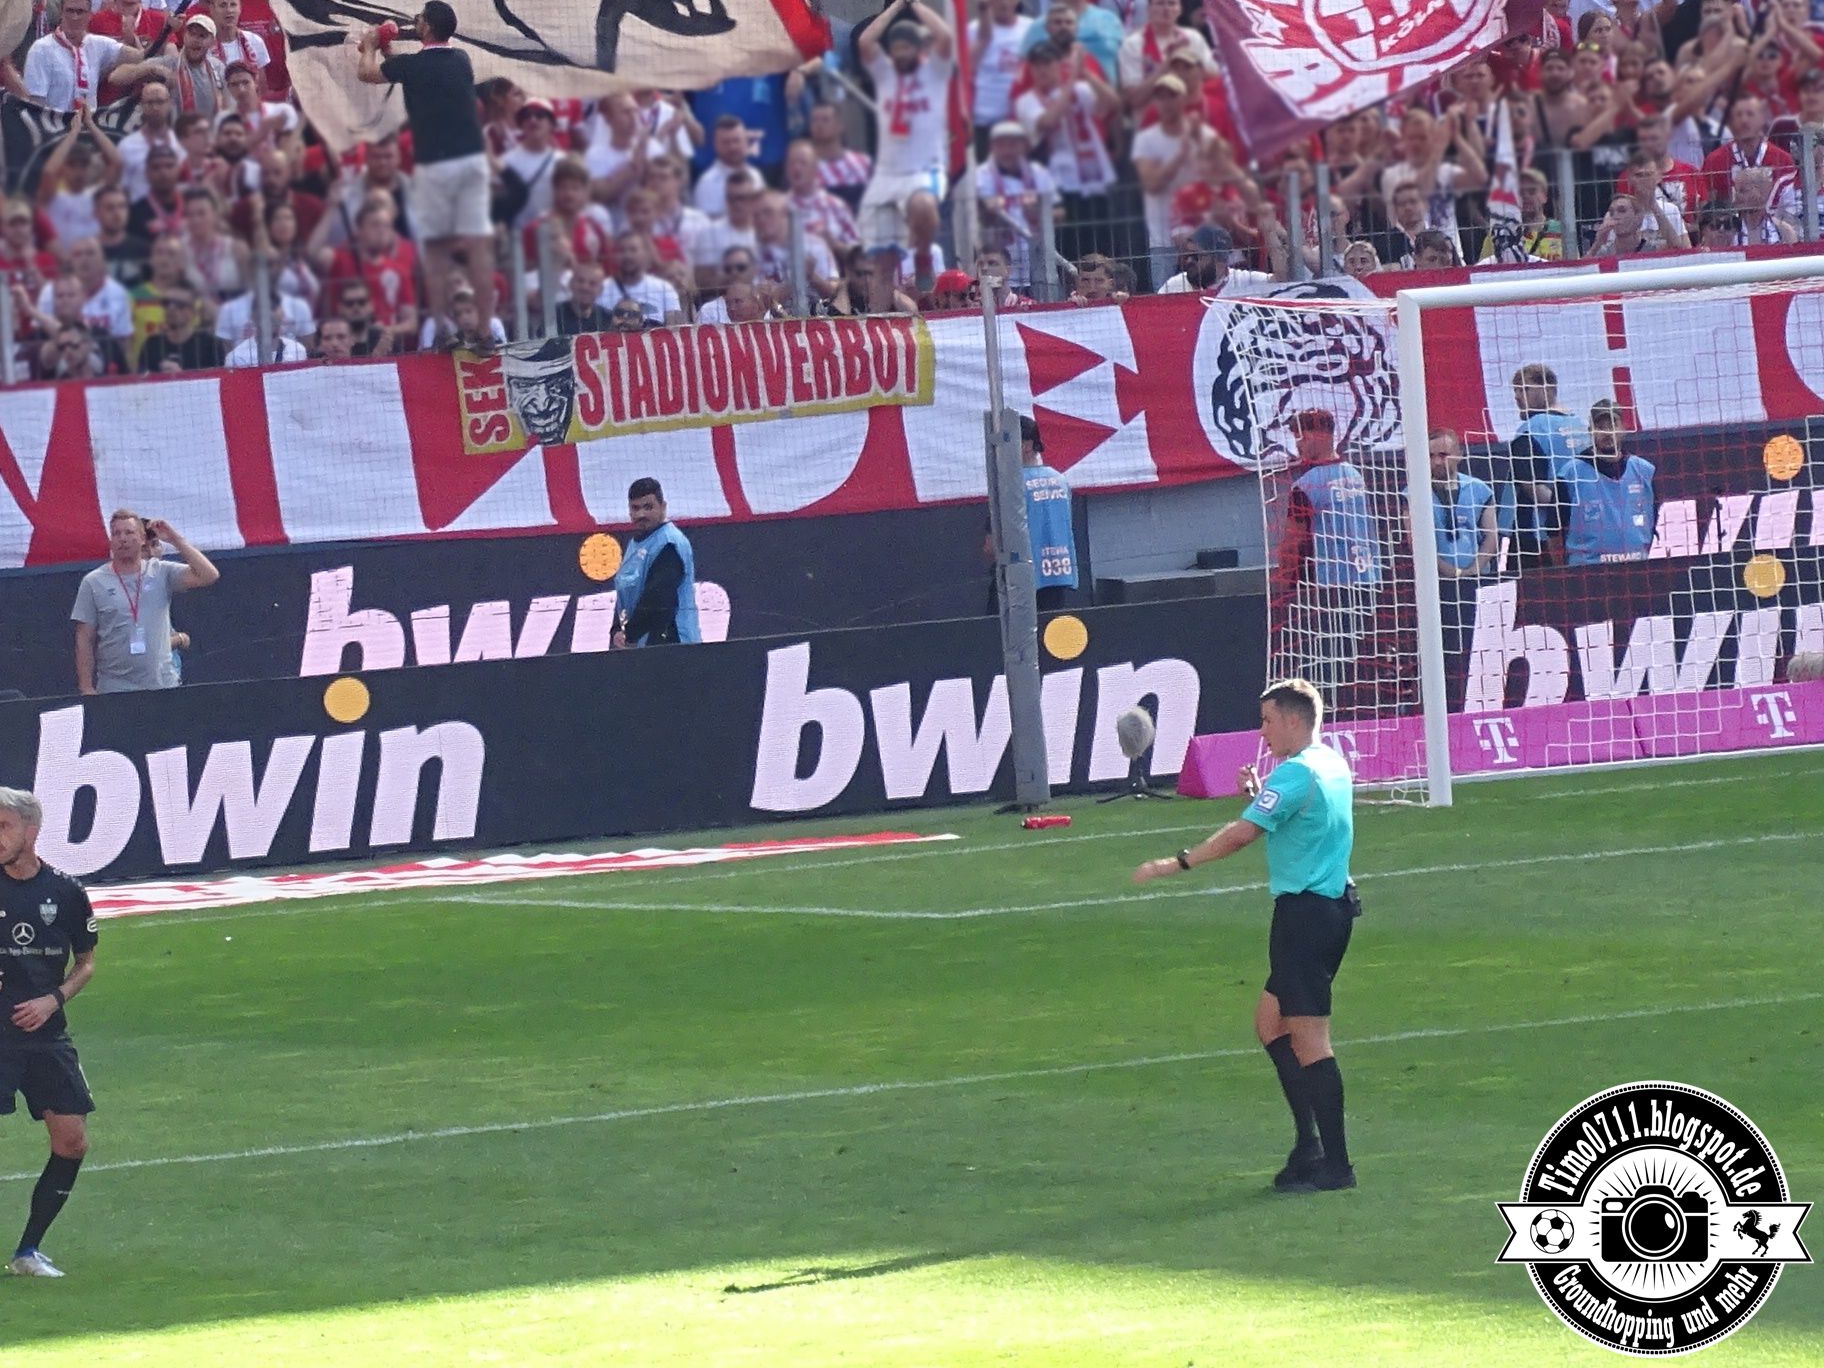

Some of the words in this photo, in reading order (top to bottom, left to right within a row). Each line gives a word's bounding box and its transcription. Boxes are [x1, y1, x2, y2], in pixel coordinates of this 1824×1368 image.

[576, 317, 919, 427] STADIONVERBOT
[33, 677, 486, 877] bwin
[750, 615, 1200, 812] bwin
